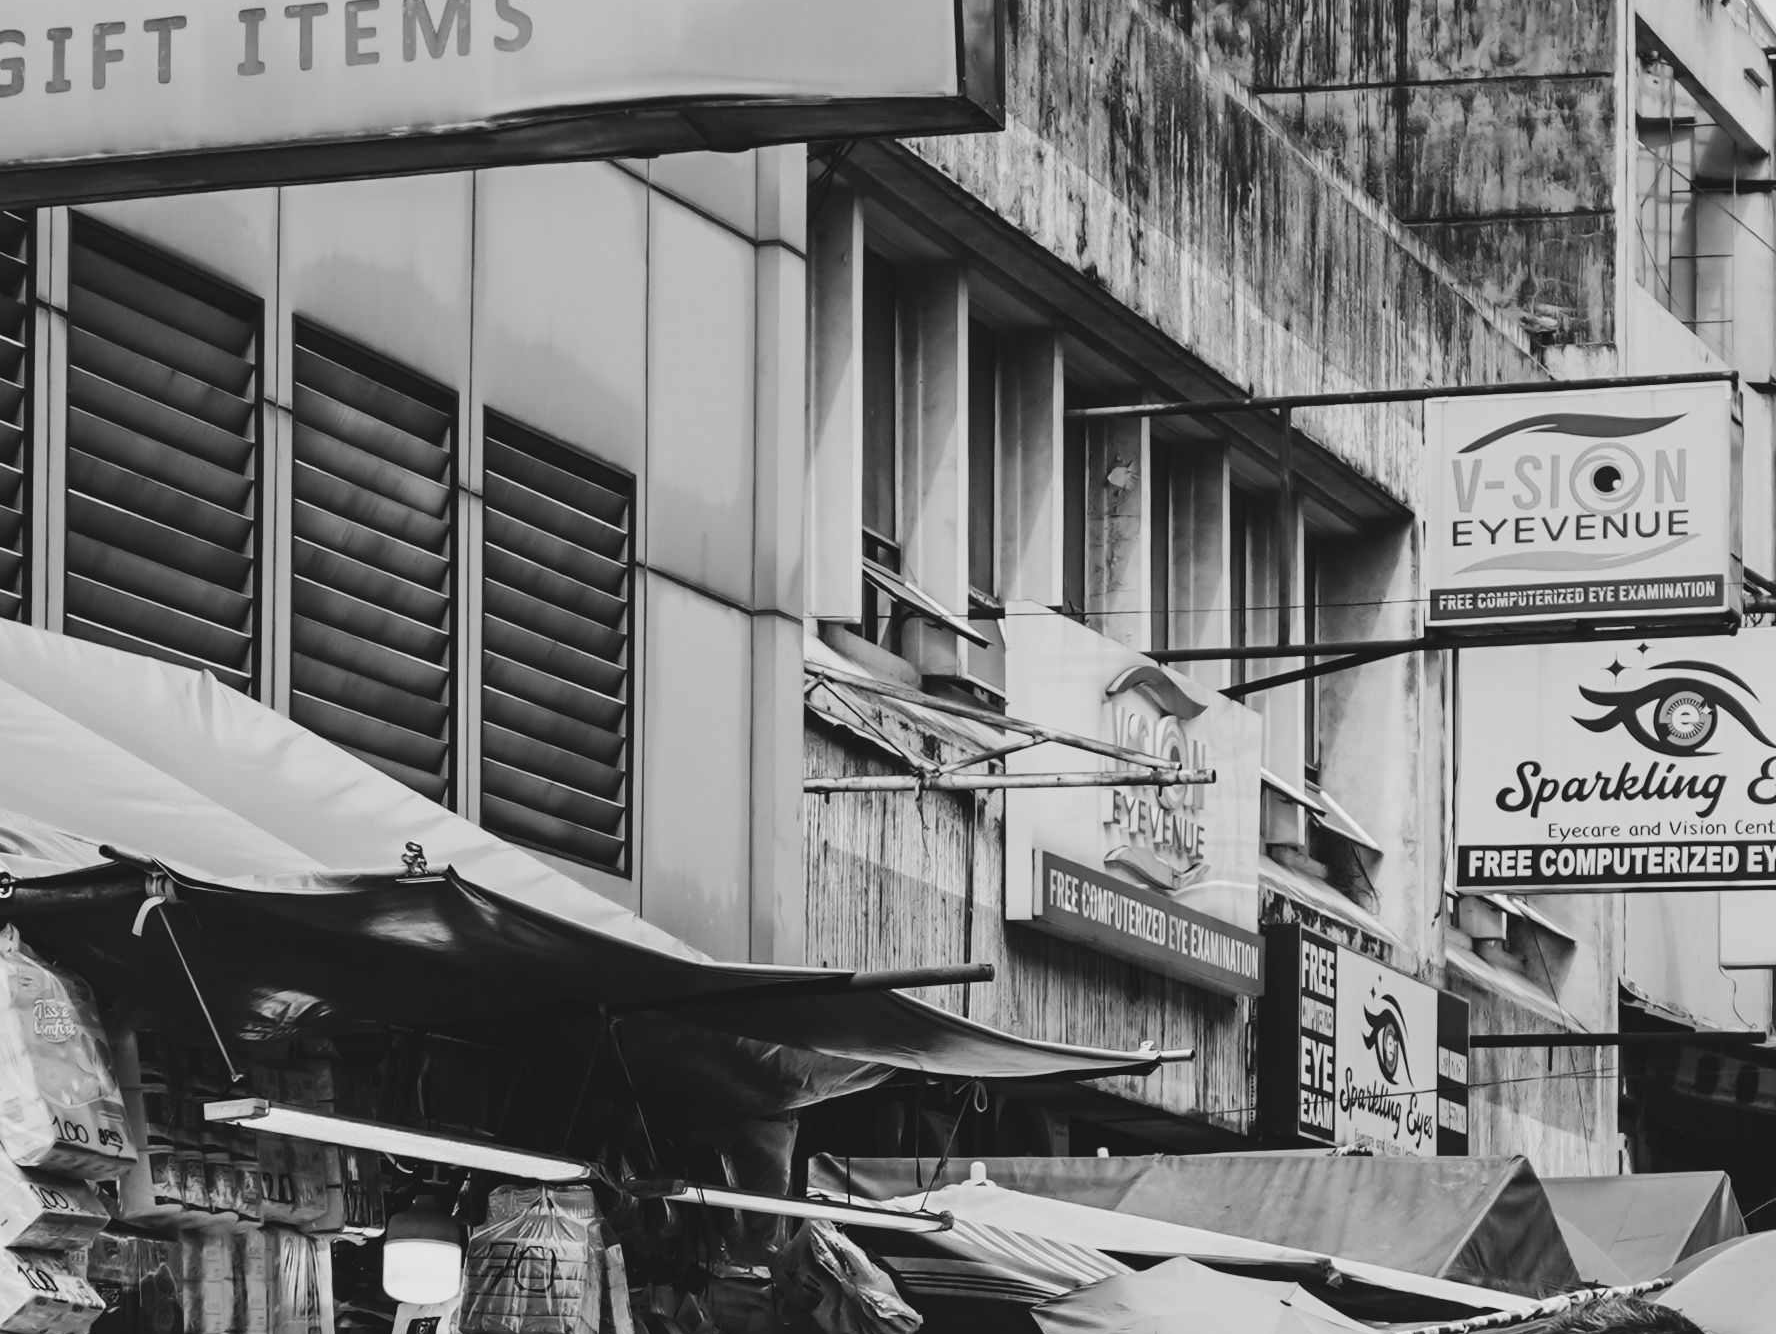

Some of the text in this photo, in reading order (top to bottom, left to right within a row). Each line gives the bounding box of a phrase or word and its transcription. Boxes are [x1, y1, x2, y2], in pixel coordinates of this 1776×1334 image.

[1452, 510, 1689, 547] EYEVENUE
[1438, 580, 1716, 611] FREE COMPUTERIZED EYE EXAMINATION
[1495, 760, 1728, 819] Sparkling
[1112, 788, 1206, 860] EYEVENUE
[1547, 822, 1621, 843] Eyecare
[1629, 820, 1661, 838] and
[1669, 820, 1727, 836] Vision
[1468, 849, 1533, 878] FREE
[1539, 845, 1740, 877] COMPUTERIZED
[1049, 868, 1260, 981] FREE COMPUTERIZED EYE EXAMINATION
[1301, 938, 1336, 1000] FREE
[1300, 1034, 1335, 1094] EYE
[52, 1115, 90, 1144] 100
[1300, 1088, 1334, 1131] EXAM
[1339, 1066, 1402, 1141] Sparkling
[1406, 1092, 1433, 1150] Eyes
